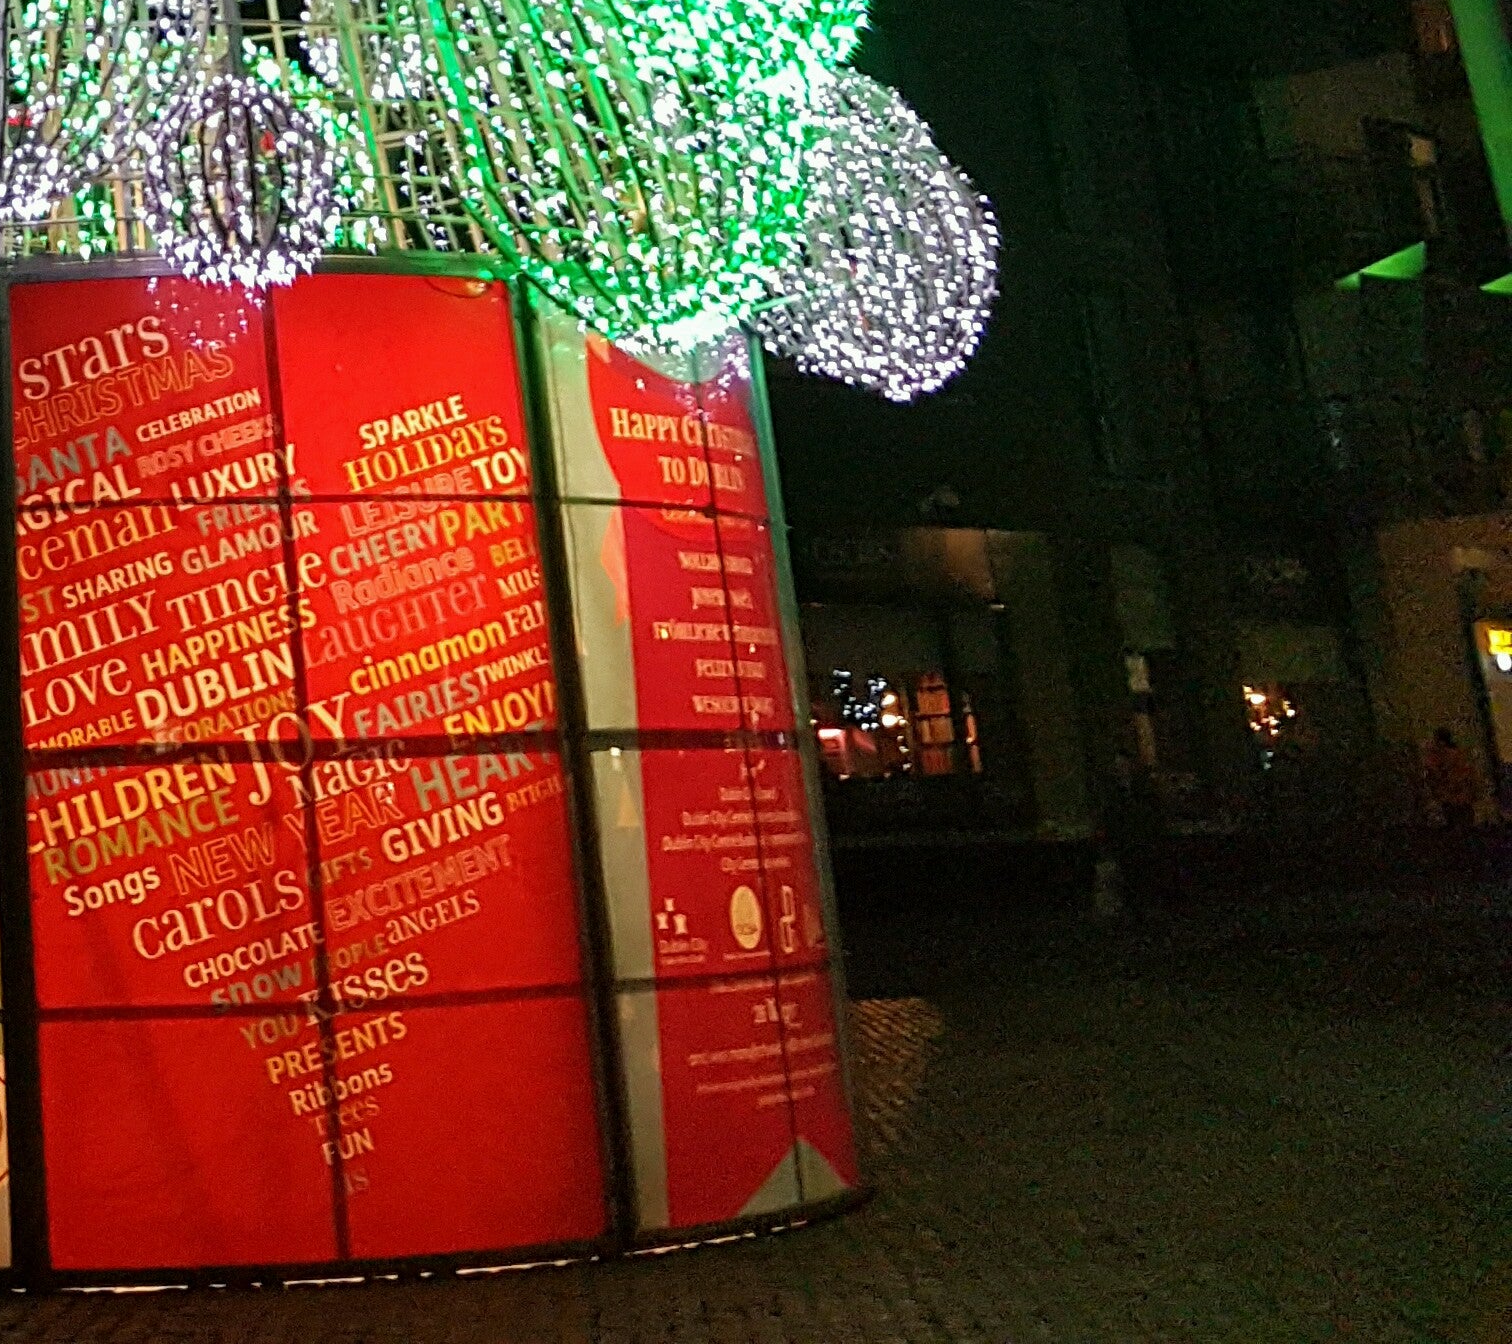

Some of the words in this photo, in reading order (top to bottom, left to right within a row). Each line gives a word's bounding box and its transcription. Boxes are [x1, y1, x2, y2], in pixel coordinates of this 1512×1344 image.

[136, 387, 261, 442] CELEBRATION
[358, 394, 468, 450] SPARKLE
[171, 443, 296, 512] LUXURY
[658, 455, 687, 484] TO
[62, 551, 174, 609] SHARING
[180, 510, 320, 575] GLAMOUR
[328, 514, 439, 576] CHEERY
[141, 598, 316, 682] HAPPINESS
[350, 620, 506, 695] cinnamon
[135, 642, 296, 729] DUBLIN
[354, 673, 480, 738] FAIRIES
[234, 691, 354, 805] JOY
[42, 786, 239, 885] ROMANCE
[168, 822, 275, 896] NEW
[382, 791, 504, 863] GIVING
[63, 865, 160, 917] Songs
[325, 834, 511, 932] EXCITEMENT
[183, 921, 325, 989] CHOCOLATE
[265, 1011, 408, 1085] PRESENTS
[321, 1127, 375, 1166] FUN
